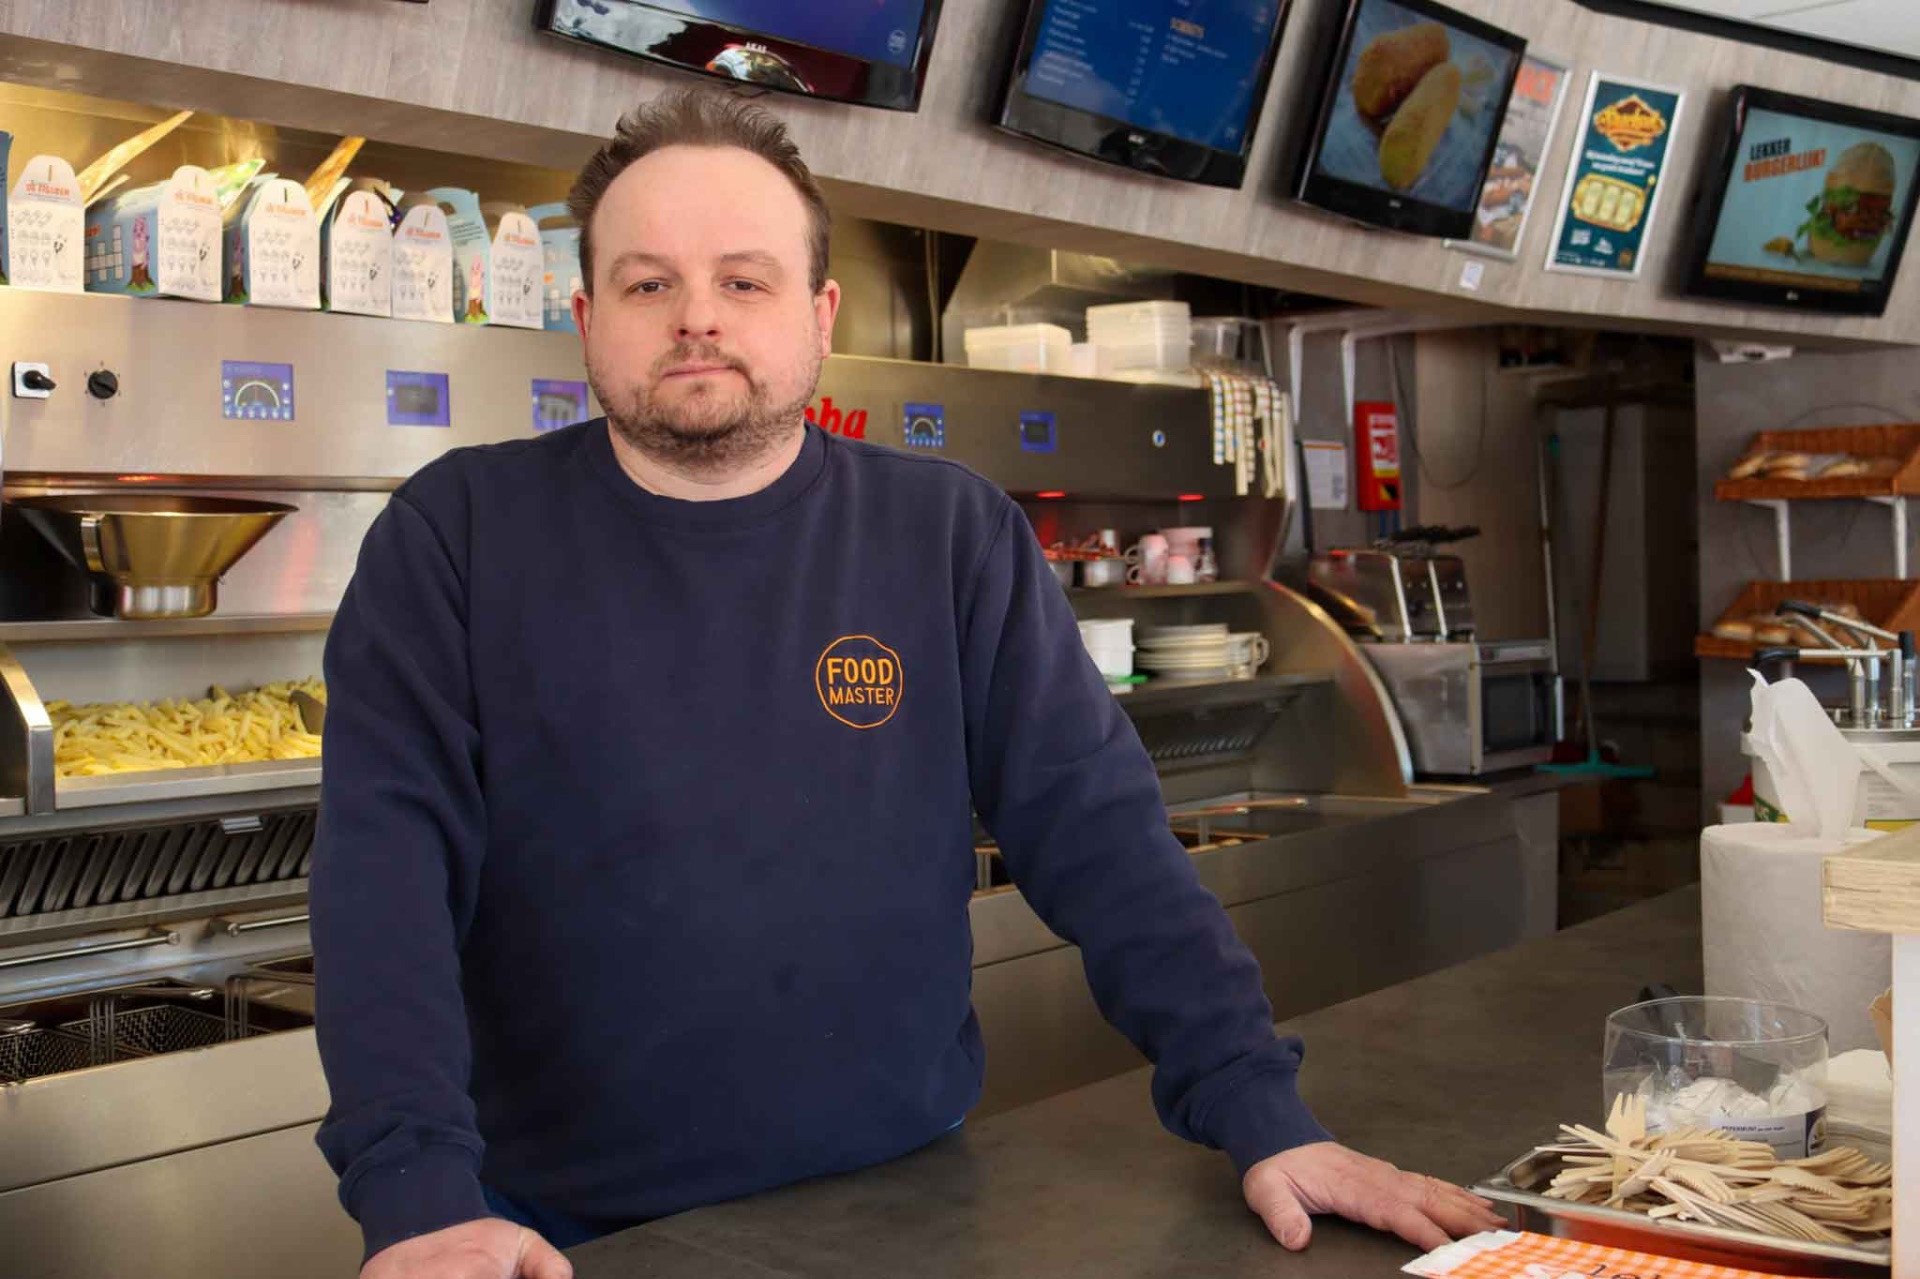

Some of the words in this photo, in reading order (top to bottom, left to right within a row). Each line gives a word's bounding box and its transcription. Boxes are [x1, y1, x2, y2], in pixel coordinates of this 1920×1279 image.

[1750, 138, 1791, 161] LEKKER
[826, 656, 894, 685] FOOD
[828, 685, 895, 706] MASTER
